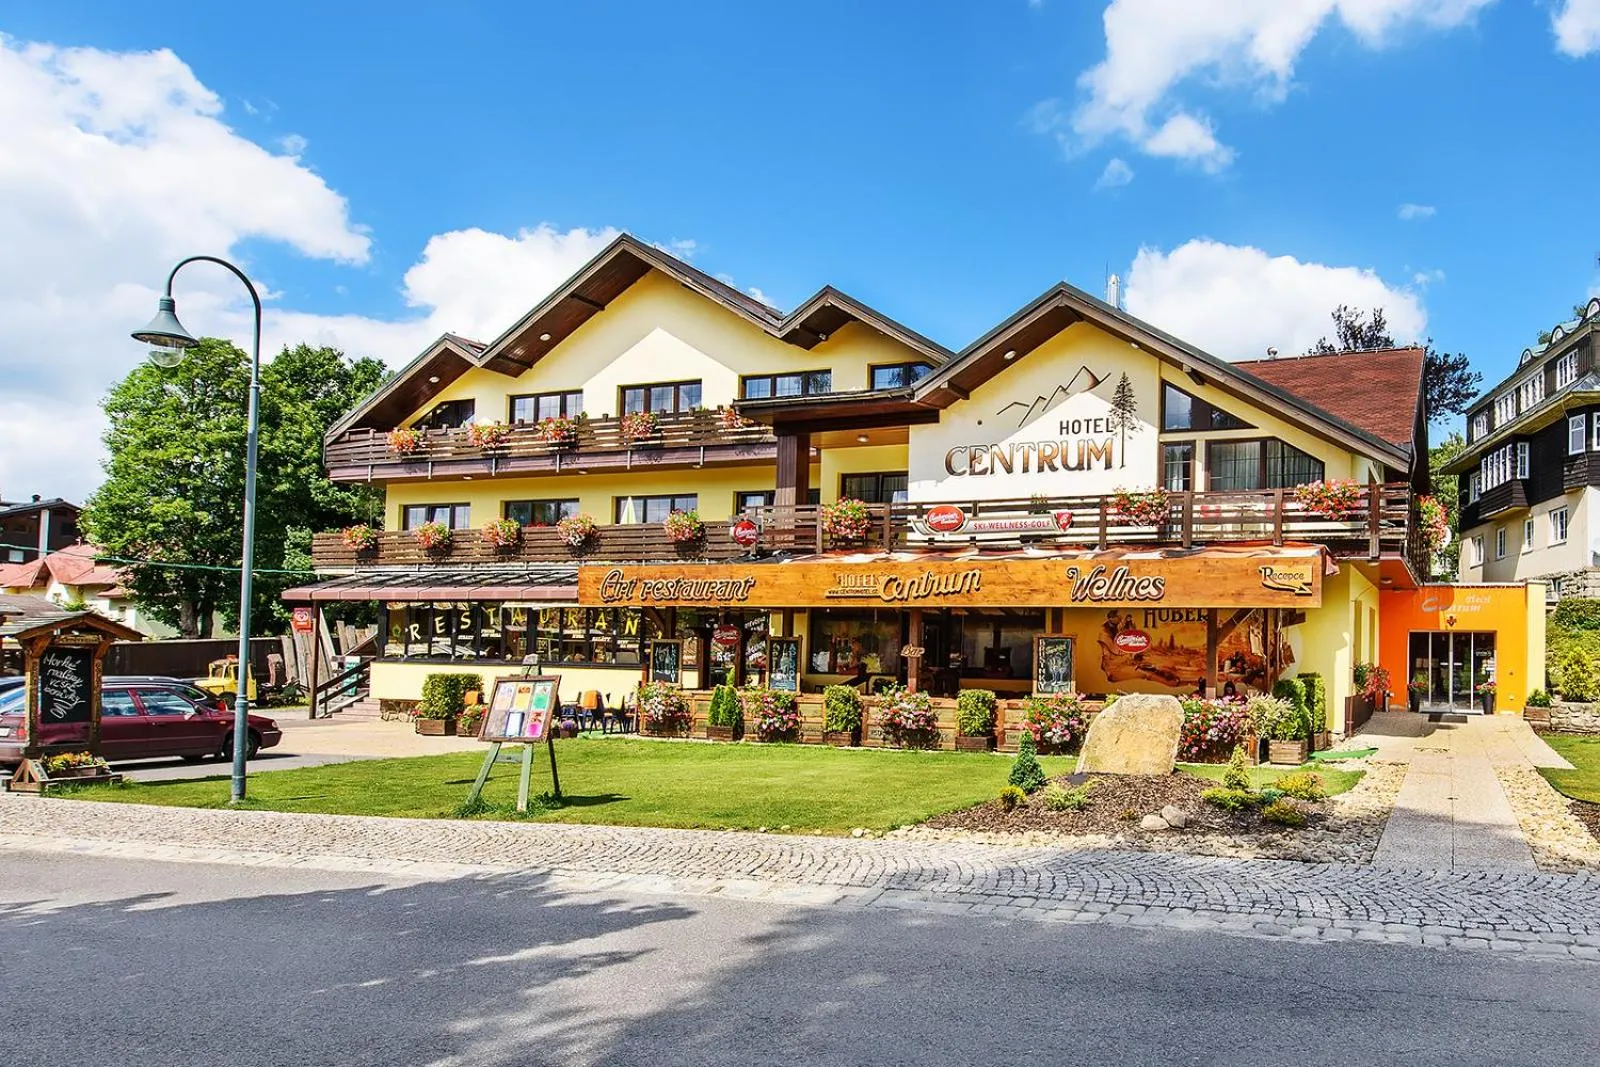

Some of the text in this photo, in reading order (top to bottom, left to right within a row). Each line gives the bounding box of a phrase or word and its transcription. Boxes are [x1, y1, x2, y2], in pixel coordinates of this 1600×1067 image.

[1059, 418, 1114, 436] HOTEL
[944, 438, 1113, 476] CENTRUM
[973, 517, 1051, 530] SKI-WELLNESS-GOLF
[601, 569, 757, 602] Art restaurant
[838, 568, 982, 602] HOTEL Centrum
[1066, 565, 1166, 602] Wellnes
[1260, 566, 1305, 581] Recepce
